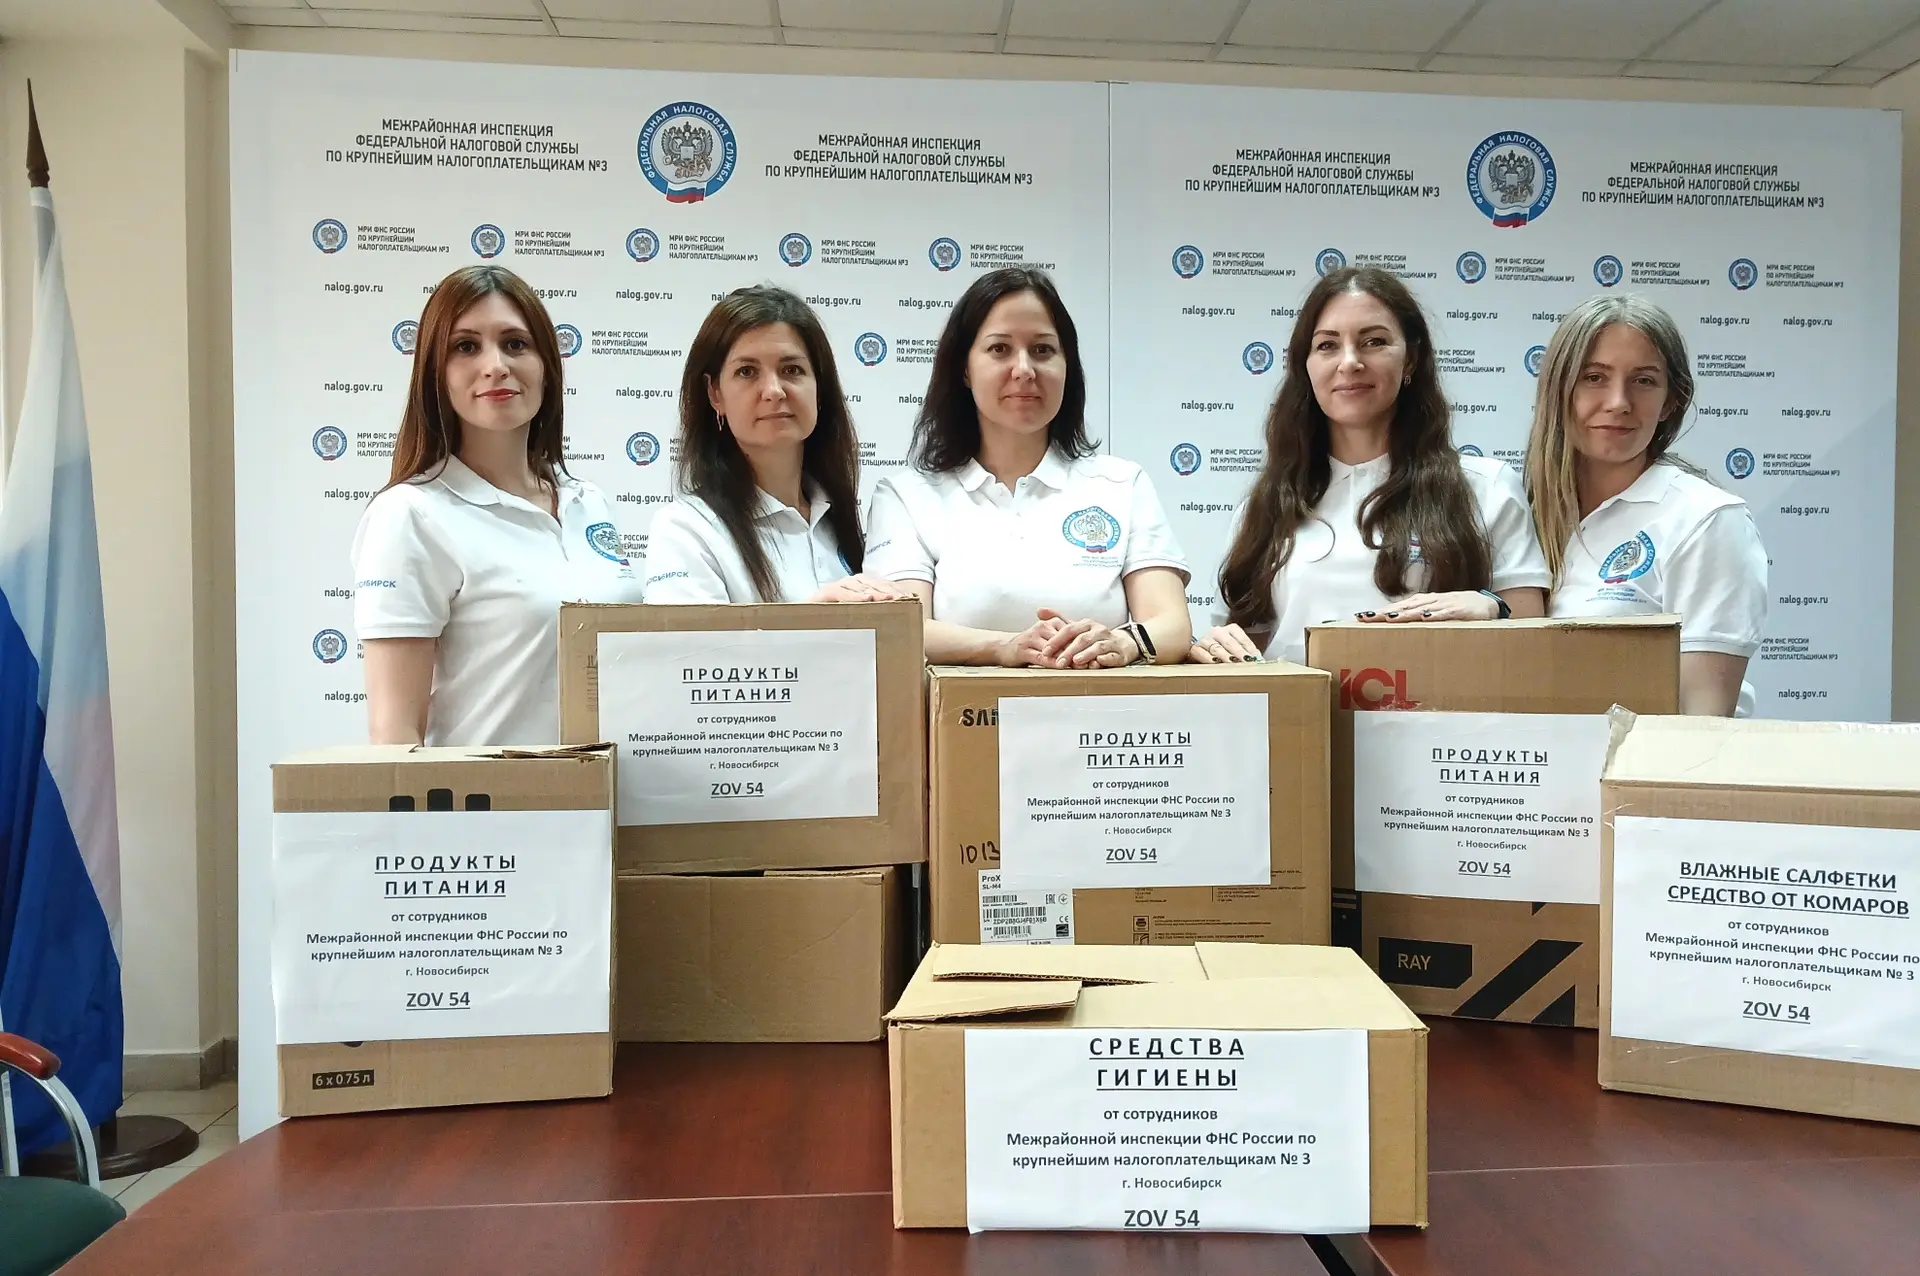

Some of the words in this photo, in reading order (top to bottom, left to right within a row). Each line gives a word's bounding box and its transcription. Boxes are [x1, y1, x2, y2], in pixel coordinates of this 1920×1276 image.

[382, 118, 476, 133] МЕЖРАЙОННАЯ
[480, 123, 552, 137] ИНСПЕКЦИЯ
[355, 134, 445, 151] ФЕДЕРАЛЬНОЙ
[450, 138, 521, 151] НАЛОГОВОЙ
[525, 141, 578, 153] СЛУЖБЫ
[640, 110, 669, 179] ФЕДЕРАЛЬНАЯ
[673, 105, 729, 137] НАЛОГОВАЯ
[716, 141, 734, 182] СЛУЖБА
[818, 133, 907, 148] МЕЖРАЙОННАЯ
[911, 137, 980, 151] ИНСПЕКЦИЯ
[326, 150, 341, 161] ПО
[346, 150, 432, 165] КРУПНЕЙШИМ
[437, 155, 584, 170] НАЛОГОПЛАТЕЛЬЩИКАМ
[793, 149, 878, 165] ФЕДЕРАЛЬНОЙ
[882, 152, 950, 165] НАЛОГОВОЙ
[954, 155, 1004, 167] СЛУЖБЫ
[1236, 148, 1321, 165] МЕЖРАЙОННАЯ
[1325, 152, 1390, 167] ИНСПЕКЦИЯ
[765, 164, 780, 176] ПО
[784, 164, 866, 178] КРУПНЕЙШИМ
[870, 169, 1010, 183] НАЛОГОПЛАТЕЛЬЩИКАМ
[1212, 164, 1293, 179] ФЕДЕРАЛЬНОЙ
[1297, 166, 1361, 178] НАЛОГОВОЙ
[1365, 168, 1413, 180] СЛУЖБЫ
[1469, 140, 1495, 204] ФЕДЕРАЛЬНАЯ
[1498, 134, 1550, 164] НАЛОГОВАЯ
[1538, 169, 1554, 208] СЛУЖБА
[1630, 160, 1711, 177] МЕЖРАЙОННАЯ
[1714, 164, 1777, 178] ИНСПЕКЦИЯ
[1185, 179, 1199, 190] ПО
[1203, 179, 1281, 192] КРУПНЕЙШИМ
[1285, 182, 1418, 196] НАЛОГОПЛАТЕЛЬЩИКАМ
[1607, 176, 1684, 192] ФЕДЕРАЛЬНОЙ
[1688, 178, 1750, 190] НАЛОГОВОЙ
[1753, 180, 1799, 191] СЛУЖБЫ
[1582, 191, 1595, 202] ПО
[1599, 190, 1673, 204] КРУПНЕЙШИМ
[1676, 194, 1804, 207] НАЛОГОПЛАТЕЛЬЩИКАМ
[324, 281, 383, 293] nalog.gov.ru
[615, 289, 672, 301] nalog.gov.ru
[806, 294, 861, 307] nalog.gov.ru
[1182, 305, 1234, 317] nalog.gov.ru
[1783, 316, 1832, 327] nalog.gov.ru
[324, 381, 382, 393] nalog.gov.ru
[1781, 407, 1830, 418] nalog.gov.ru
[616, 491, 673, 504] nalog.gov.ru
[1180, 501, 1232, 513] nalog.gov.ru
[1779, 594, 1828, 605] nalog.gov.ru
[683, 667, 798, 681] ПРОДУКТЫ
[691, 688, 790, 701] ПИТАНИЯ
[1079, 732, 1190, 745] ПРОДУКТЫ
[1087, 753, 1183, 766] ПИТАНИЯ
[1431, 748, 1547, 763] ПРОДУКТЫ
[1439, 768, 1538, 783] ПИТАНИЯ
[711, 782, 741, 796] ZOV
[744, 782, 763, 796] 54
[1106, 848, 1135, 860] ZOV
[1139, 848, 1156, 860] 54
[376, 855, 515, 871] ПРОДУКТЫ
[1458, 860, 1488, 873] ZOV
[1493, 862, 1510, 874] 54
[1680, 862, 1780, 881] ВЛАЖНЫЕ
[1786, 869, 1896, 889] САЛФЕТКИ
[385, 880, 504, 894] ПИТАНИЯ
[1668, 886, 1766, 904] СРЕДСТВО
[1772, 892, 1798, 907] ОТ
[1804, 894, 1909, 915] КОМАРОВ
[408, 912, 487, 922] сотрудников
[1745, 922, 1828, 935] сотрудников
[306, 931, 401, 944] Межрайонной
[405, 932, 472, 941] инспекции
[476, 930, 503, 939] ФНС
[507, 929, 548, 939] России
[552, 930, 567, 938] по
[311, 948, 395, 961] крупнейшим
[399, 948, 534, 957] налогоплательщикам
[538, 945, 552, 955] №
[555, 944, 562, 954] 3
[1645, 932, 1737, 948] Межрайонной
[1741, 942, 1813, 955] инспекции
[1817, 946, 1846, 957] ФНС
[1851, 948, 1898, 961] России
[1903, 955, 1919, 963] по
[1398, 953, 1431, 970] RAY
[1650, 951, 1731, 963] крупнейшим
[1735, 958, 1881, 976] налогоплательщикам
[1886, 968, 1902, 979] №
[1906, 970, 1914, 980] 3
[416, 965, 489, 976] Новосибирск
[1753, 976, 1830, 991] Новосибирск
[406, 992, 443, 1006] ZOV
[449, 991, 470, 1006] 54
[1742, 1001, 1781, 1018] ZOV
[1787, 1004, 1810, 1020] 54
[1089, 1038, 1243, 1058] СРЕДСТВА
[1097, 1069, 1235, 1086] ГИГИЕНЫ
[1103, 1110, 1119, 1119] от
[1123, 1110, 1217, 1122] сотрудников
[1007, 1132, 1115, 1147] Межрайонной
[1120, 1135, 1200, 1146] инспекции
[1205, 1132, 1237, 1144] ФНС
[1242, 1132, 1293, 1144] России
[1298, 1134, 1315, 1143] по
[1013, 1153, 1109, 1168] крупнейшим
[1114, 1155, 1276, 1166] налогоплательщикам
[1280, 1152, 1297, 1164] №
[1302, 1152, 1310, 1164] 3
[1122, 1180, 1130, 1188] г.
[1134, 1177, 1221, 1189] Новосибирск
[1124, 1209, 1167, 1226] ZOV
[1174, 1209, 1199, 1226] 54
